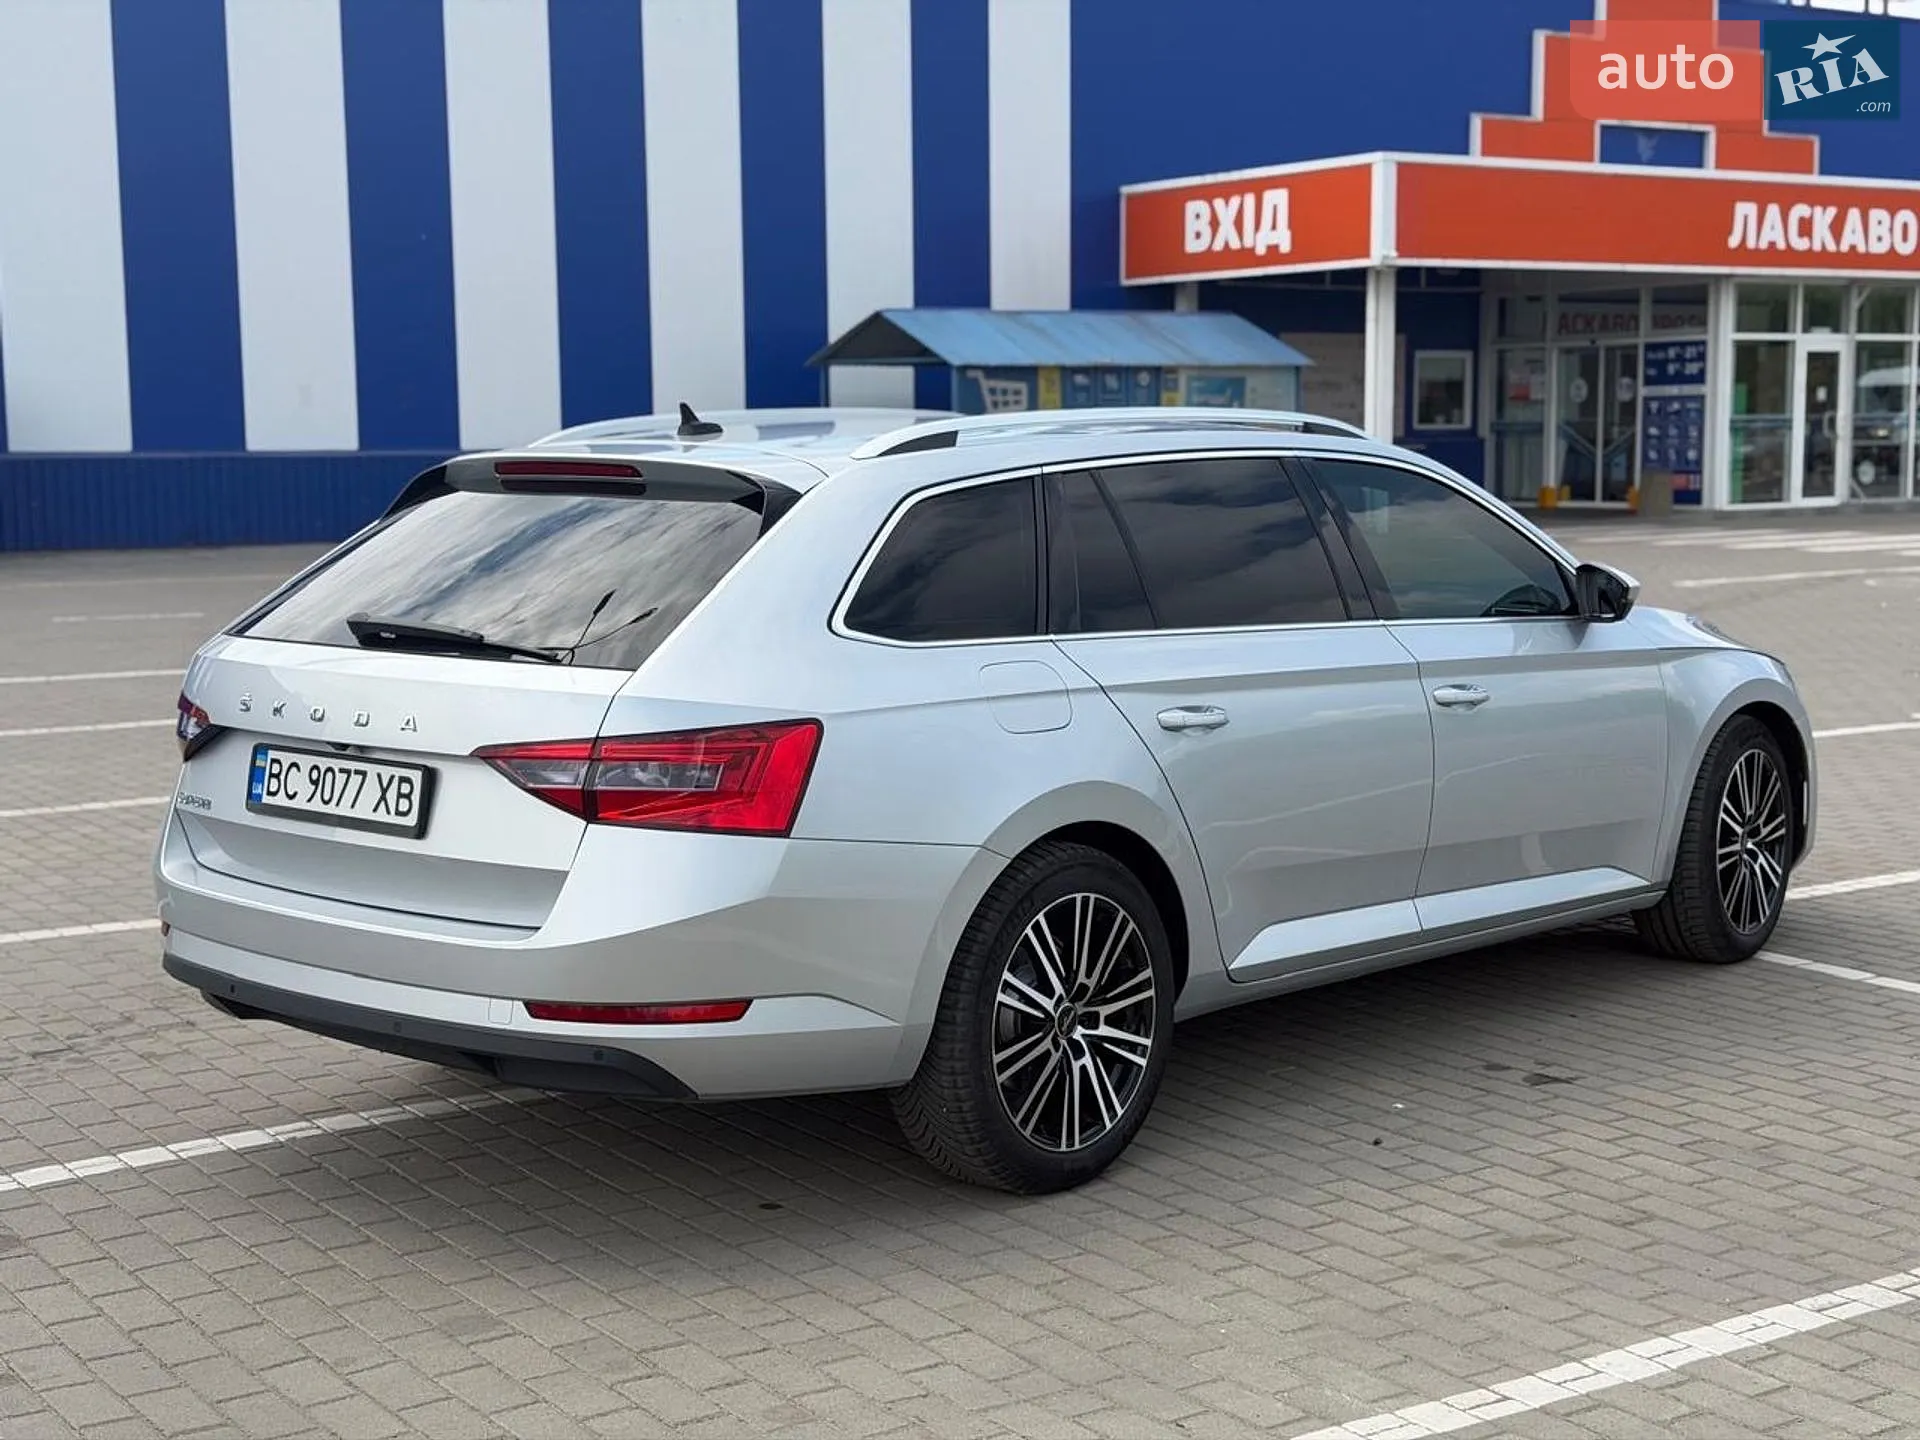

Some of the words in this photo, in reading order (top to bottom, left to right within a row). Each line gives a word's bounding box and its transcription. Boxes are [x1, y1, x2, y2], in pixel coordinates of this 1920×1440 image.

[1184, 187, 1292, 256] ВХІД
[1727, 201, 1919, 256] ЛАСКАВО
[265, 757, 301, 801] BC
[306, 764, 368, 809] 9077
[372, 772, 415, 818] XB
